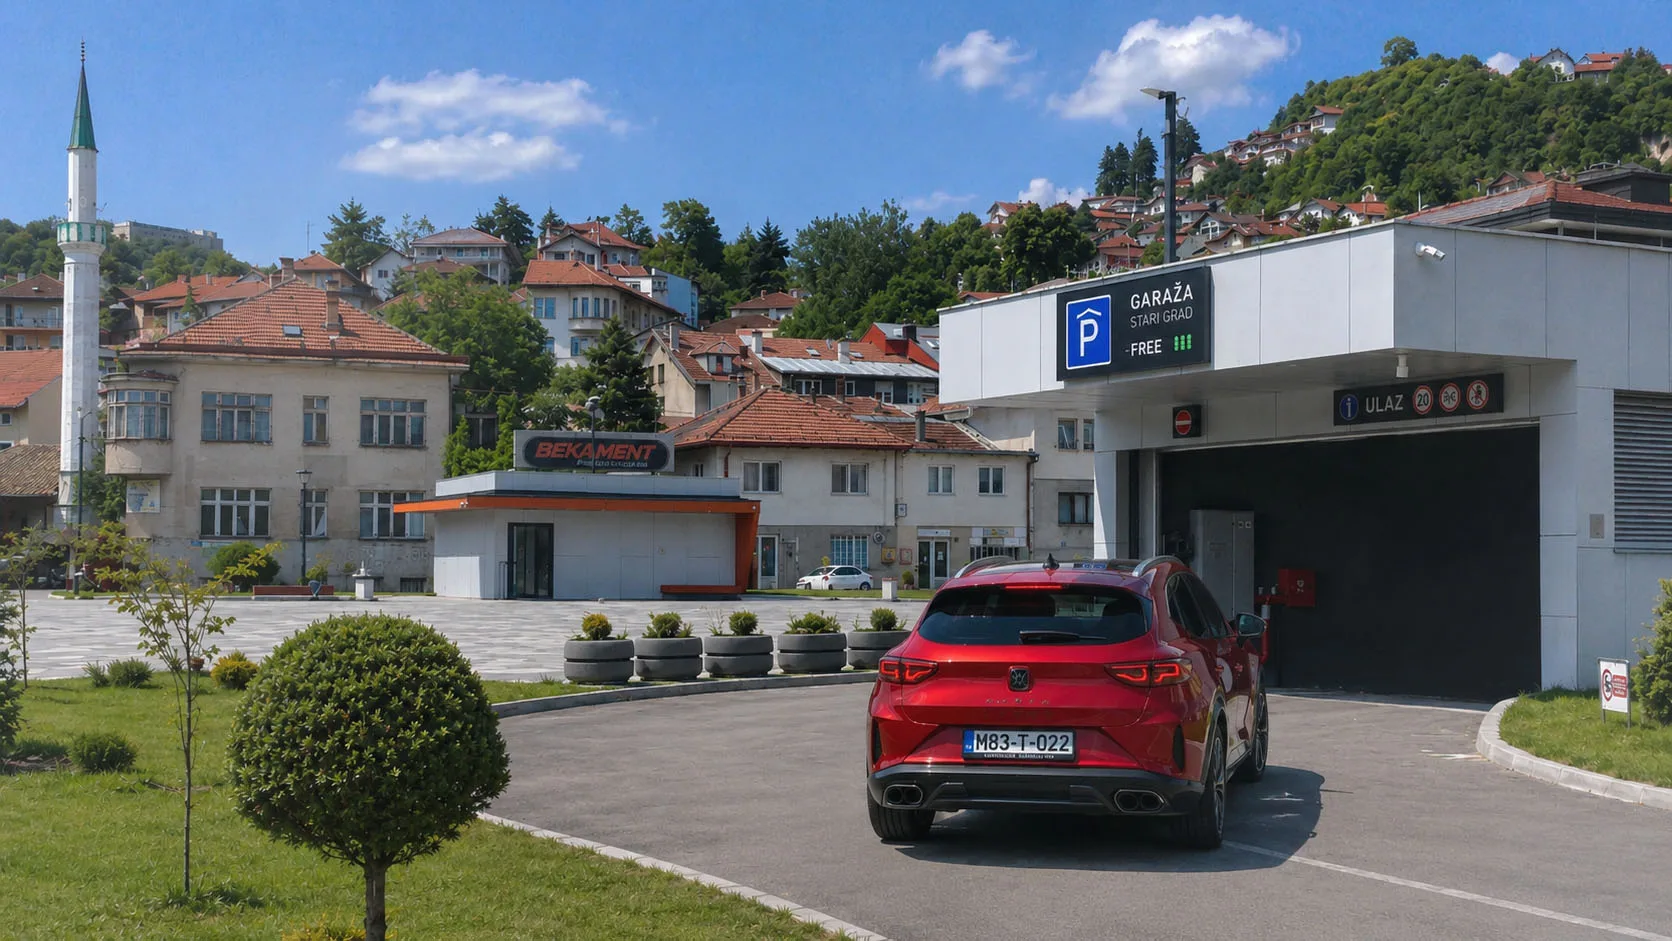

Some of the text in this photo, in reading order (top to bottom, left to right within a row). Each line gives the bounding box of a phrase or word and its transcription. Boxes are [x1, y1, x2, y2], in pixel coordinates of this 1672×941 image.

[1130, 281, 1193, 310] GARAŽA
[1130, 306, 1193, 329] STARI GRAD
[1130, 338, 1163, 357] FREE
[1365, 394, 1404, 414] ULAZ
[1417, 393, 1429, 407] 20
[535, 441, 657, 460] BEKAMENT
[975, 733, 1070, 752] M83-T-022
